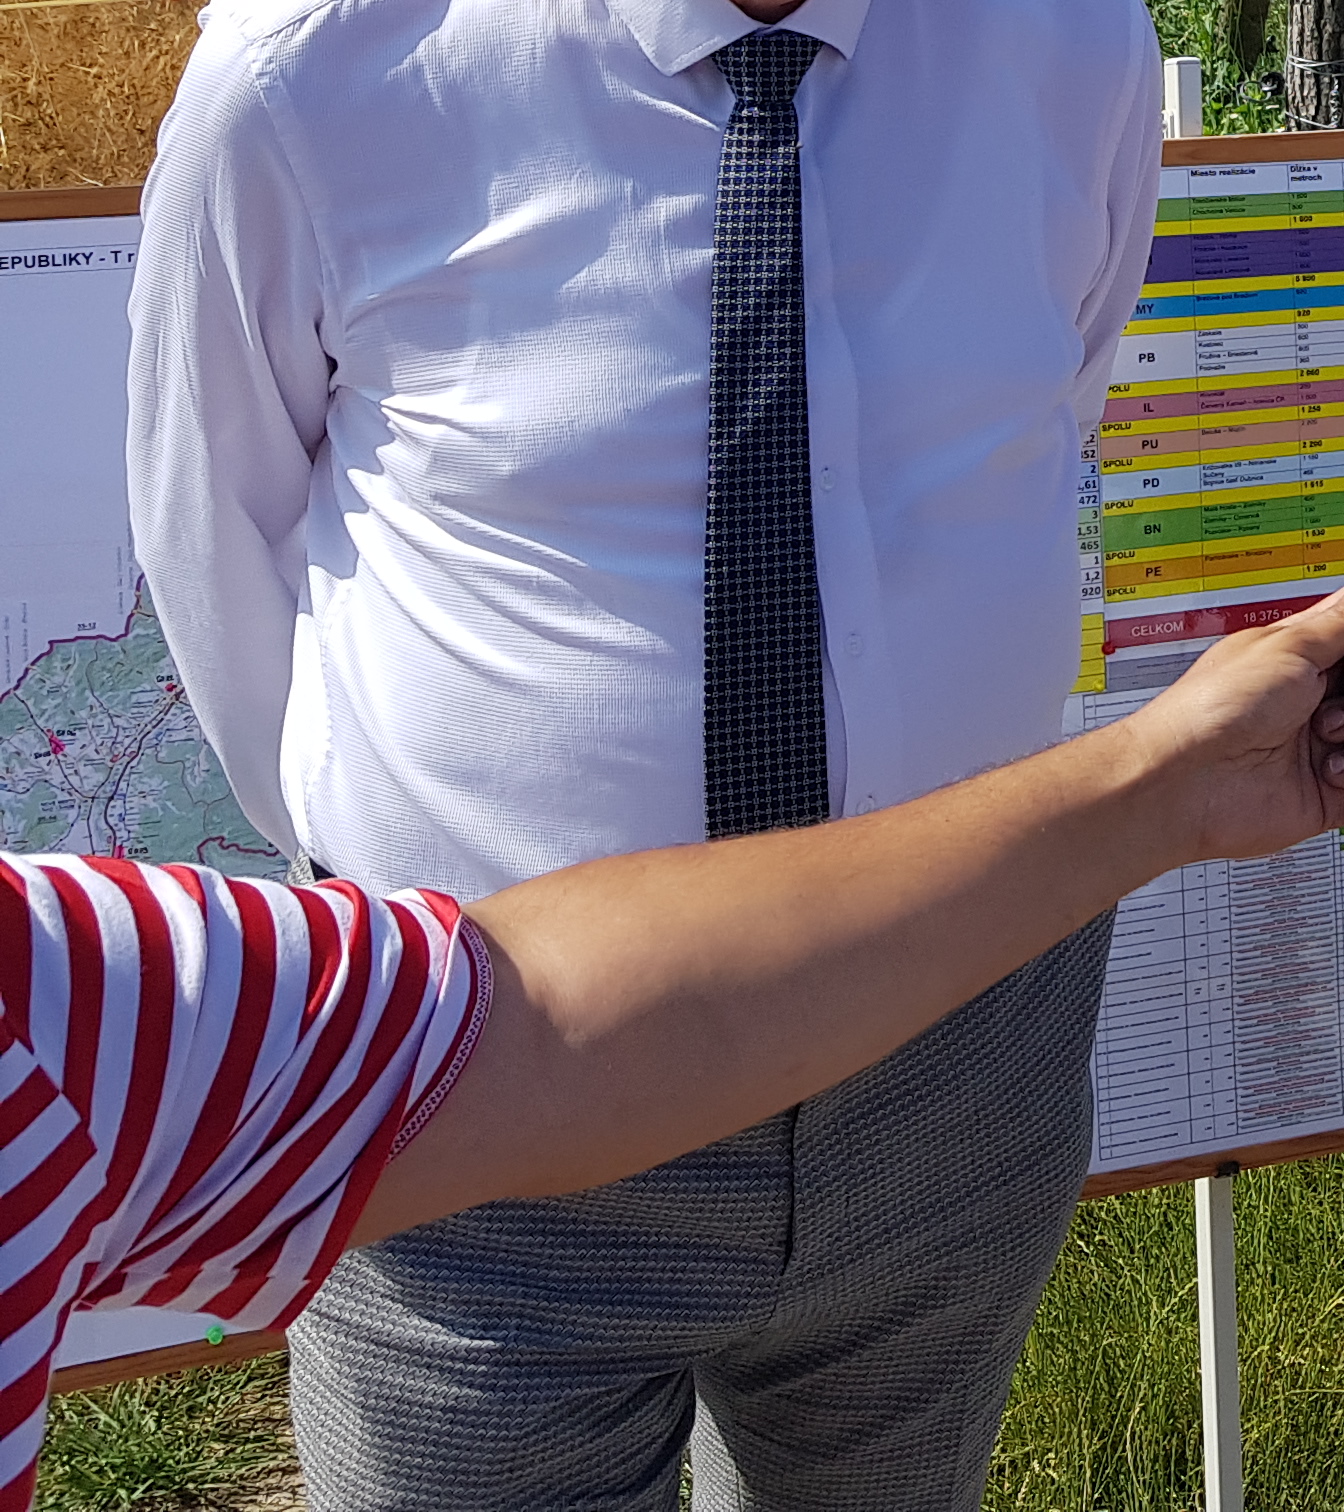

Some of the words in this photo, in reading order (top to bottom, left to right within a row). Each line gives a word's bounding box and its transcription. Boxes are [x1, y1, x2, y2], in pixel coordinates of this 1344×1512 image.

[1136, 304, 1155, 315] MY
[1138, 352, 1156, 363] PB
[1143, 403, 1155, 413] IL
[1142, 439, 1158, 450] PU
[1090, 464, 1097, 474] 2
[1078, 479, 1097, 491] ,61
[1143, 478, 1160, 489] PD
[1078, 495, 1098, 505] 472
[1092, 510, 1098, 519] 3
[1077, 526, 1099, 537] 1,53
[1143, 524, 1161, 535] BN
[1080, 541, 1099, 551] 465
[1085, 571, 1100, 583] 1,2
[1145, 566, 1163, 577] PE
[1081, 586, 1102, 597] 920
[1243, 613, 1257, 624] 18
[1259, 608, 1280, 621] 375
[1131, 620, 1184, 637] CELKOM
